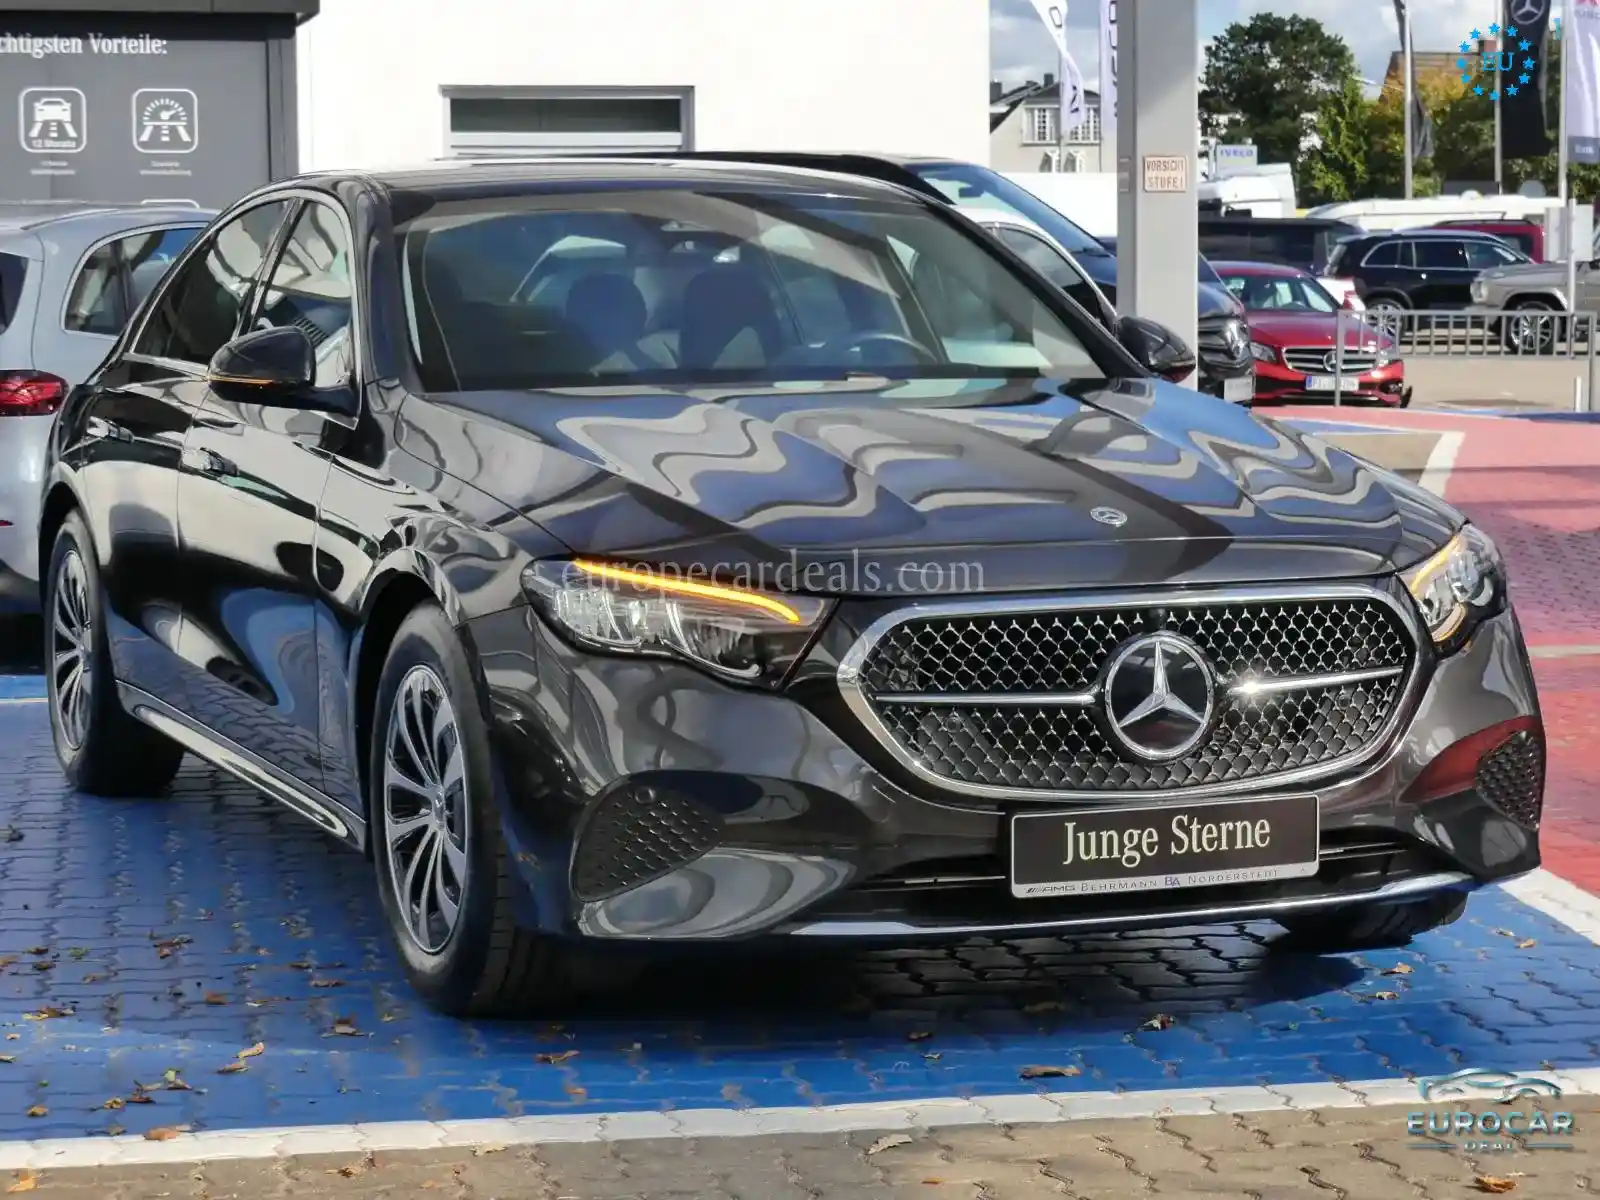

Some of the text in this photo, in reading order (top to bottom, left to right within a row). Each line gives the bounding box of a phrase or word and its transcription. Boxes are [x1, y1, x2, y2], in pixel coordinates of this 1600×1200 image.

[88, 33, 167, 54] Vorteile:
[1220, 148, 1254, 157] IVECO
[1146, 160, 1184, 171] VORSICHT
[1063, 815, 1271, 868] Junge Sterne
[1081, 879, 1157, 893] BEHRMANN
[1188, 869, 1278, 885] NORDERSTEDT
